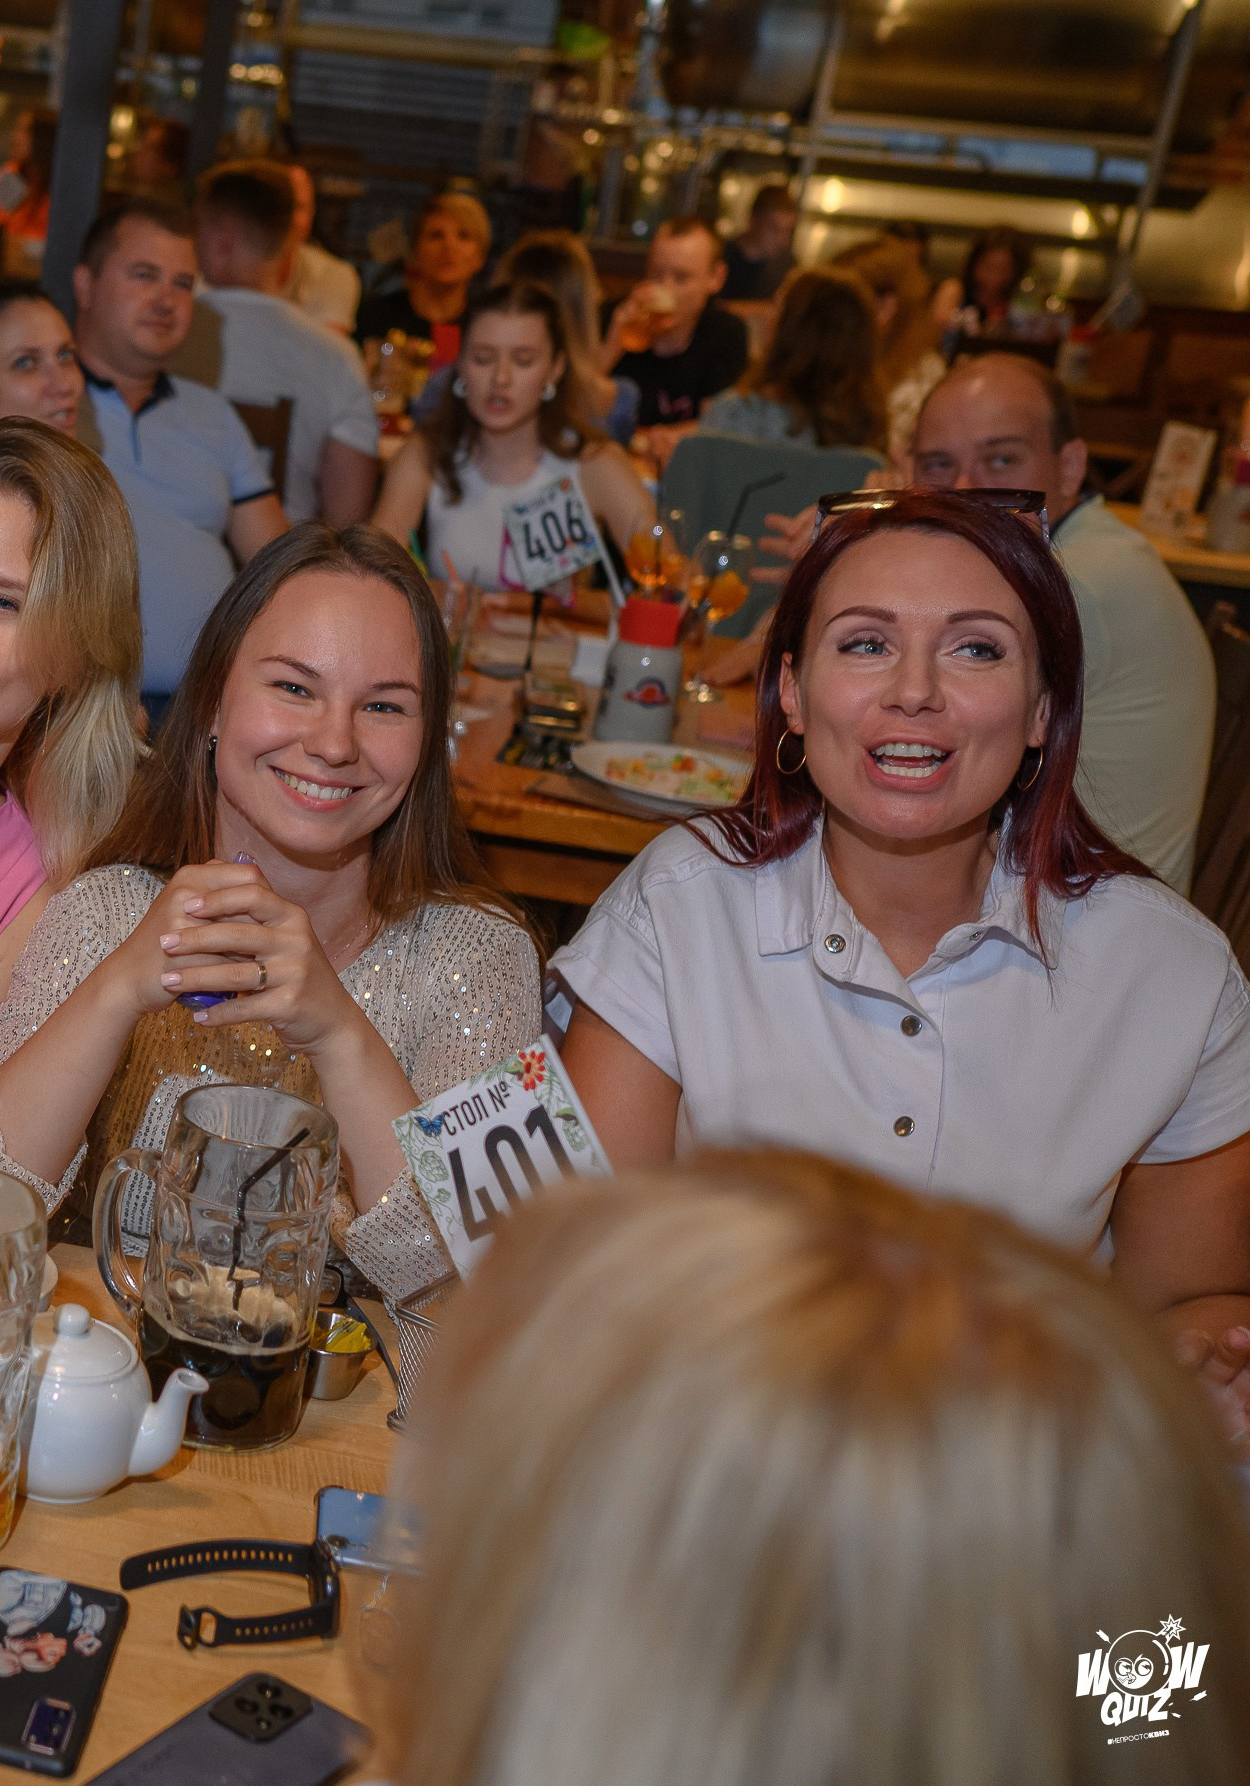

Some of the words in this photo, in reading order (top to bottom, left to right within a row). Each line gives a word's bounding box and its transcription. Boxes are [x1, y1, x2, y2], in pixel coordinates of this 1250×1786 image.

[524, 500, 587, 558] 406
[442, 1094, 489, 1136] СТОЛ
[448, 1104, 577, 1241] 401
